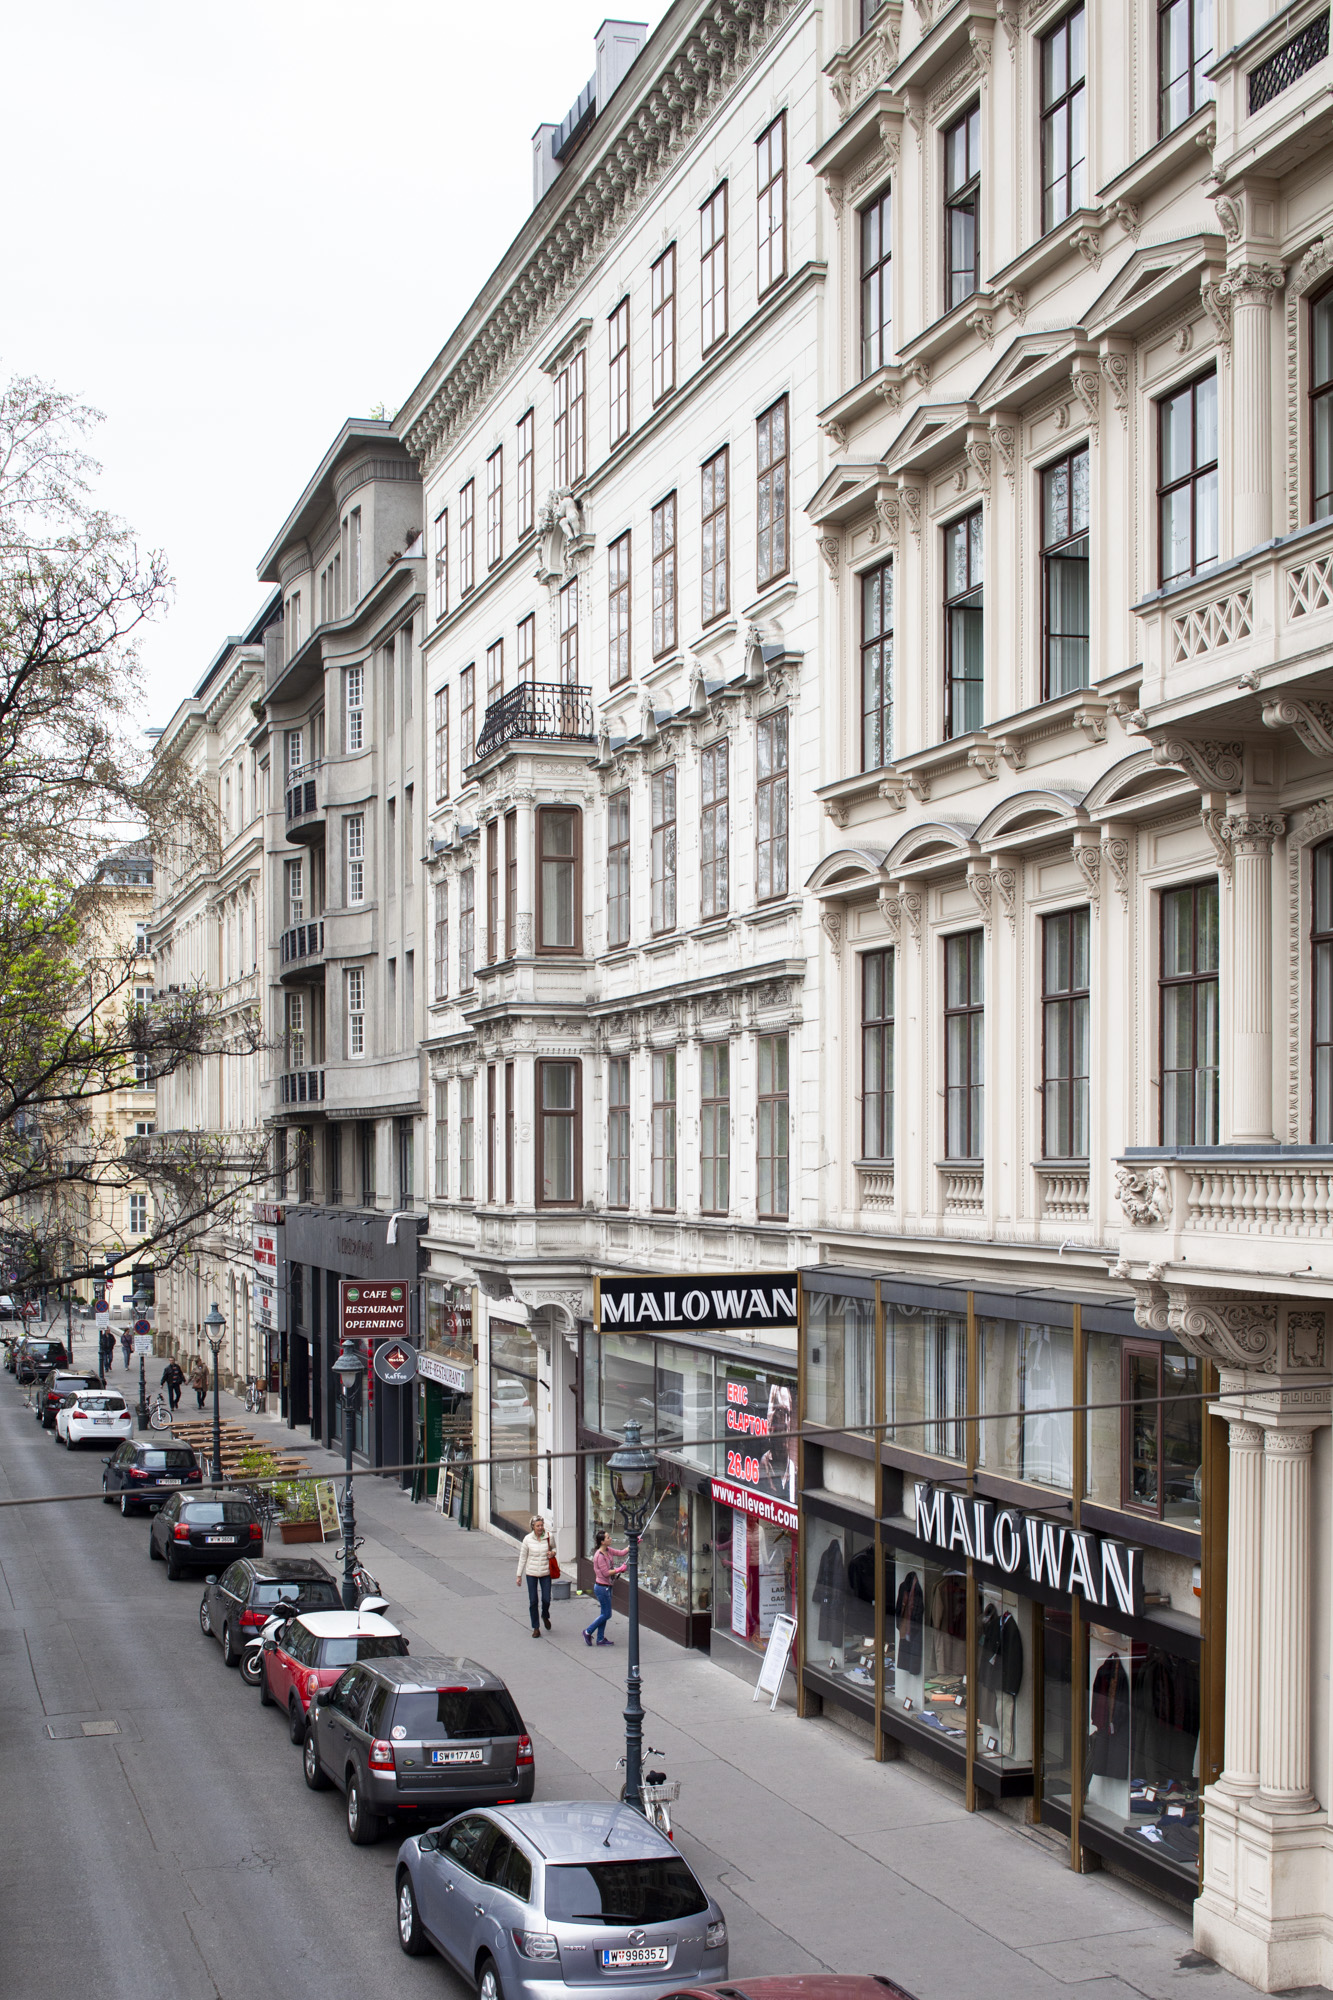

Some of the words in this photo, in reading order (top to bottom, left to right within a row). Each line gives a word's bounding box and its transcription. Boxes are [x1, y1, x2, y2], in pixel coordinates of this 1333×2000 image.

[362, 1290, 388, 1299] CAFE
[345, 1305, 405, 1314] RESTAURANT
[600, 1288, 797, 1323] MALOWAN
[345, 1320, 404, 1329] OPERNRING
[384, 1372, 407, 1380] Kaffee
[727, 1382, 748, 1406] ERIC
[727, 1408, 769, 1436] CLAPTON
[727, 1450, 759, 1484] 26.06
[711, 1483, 799, 1530] www.allevent.com
[914, 1482, 1136, 1616] MALOWAN
[438, 1751, 450, 1761] SW
[456, 1751, 468, 1760] 177
[470, 1750, 480, 1759] AG
[611, 1951, 618, 1961] W
[625, 1948, 656, 1961] 99635
[658, 1948, 664, 1959] Z
